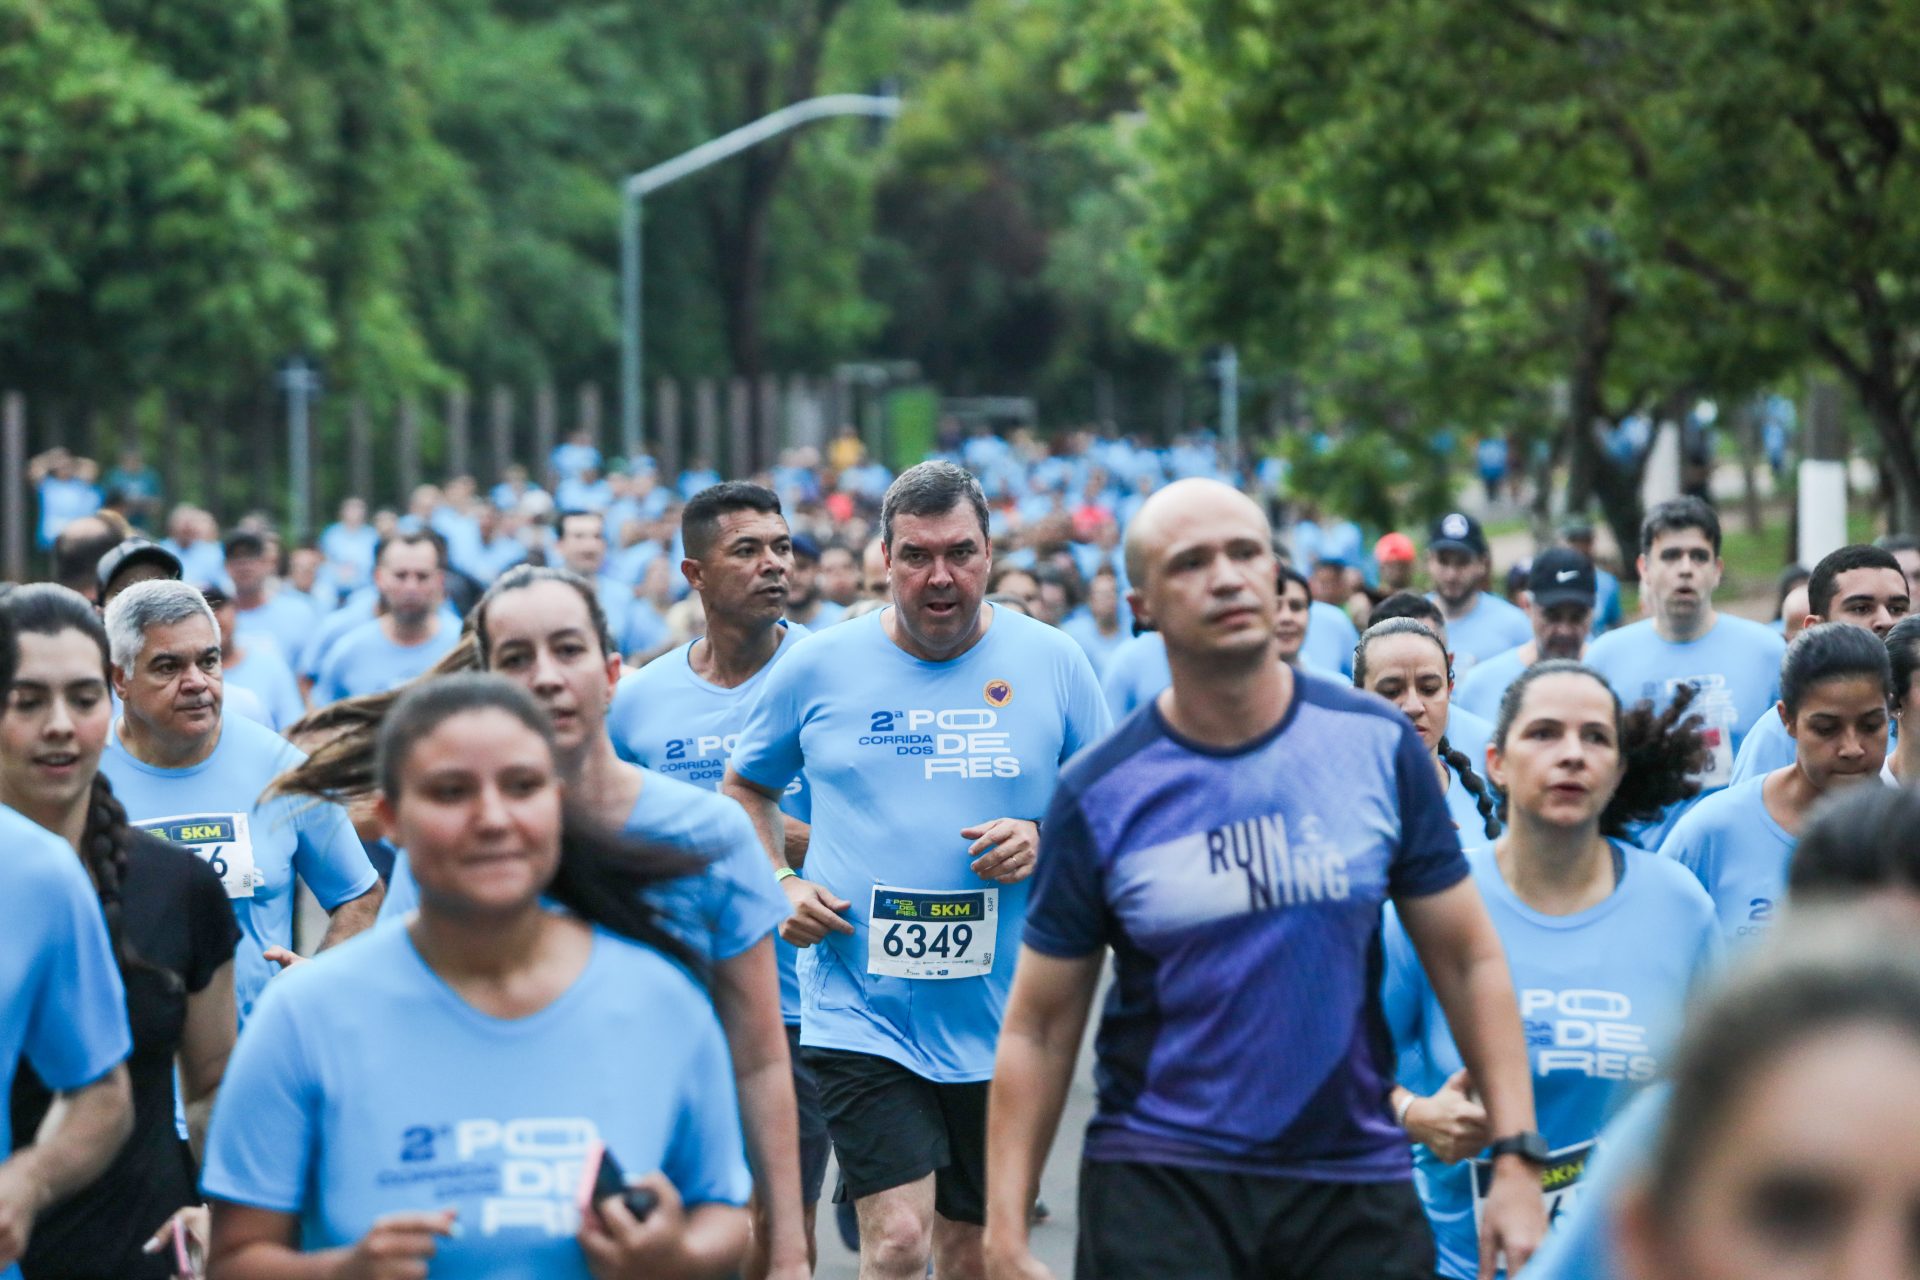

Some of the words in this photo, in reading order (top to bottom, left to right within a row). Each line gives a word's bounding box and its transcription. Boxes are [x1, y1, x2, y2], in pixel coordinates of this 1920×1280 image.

[871, 710, 904, 732] 2ª
[909, 708, 998, 731] PO
[859, 735, 933, 745] CORRIDA
[896, 746, 934, 755] DOS
[936, 732, 1011, 755] DE
[660, 759, 722, 773] CORRIDA
[690, 769, 723, 781] DOS
[924, 756, 1021, 780] RES
[181, 825, 221, 840] 5KM
[930, 903, 970, 916] 5KM
[883, 923, 973, 958] 6349
[1520, 988, 1632, 1019] PO
[1555, 1019, 1649, 1051] DE
[1538, 1050, 1657, 1081] RES
[456, 1117, 599, 1160] PO
